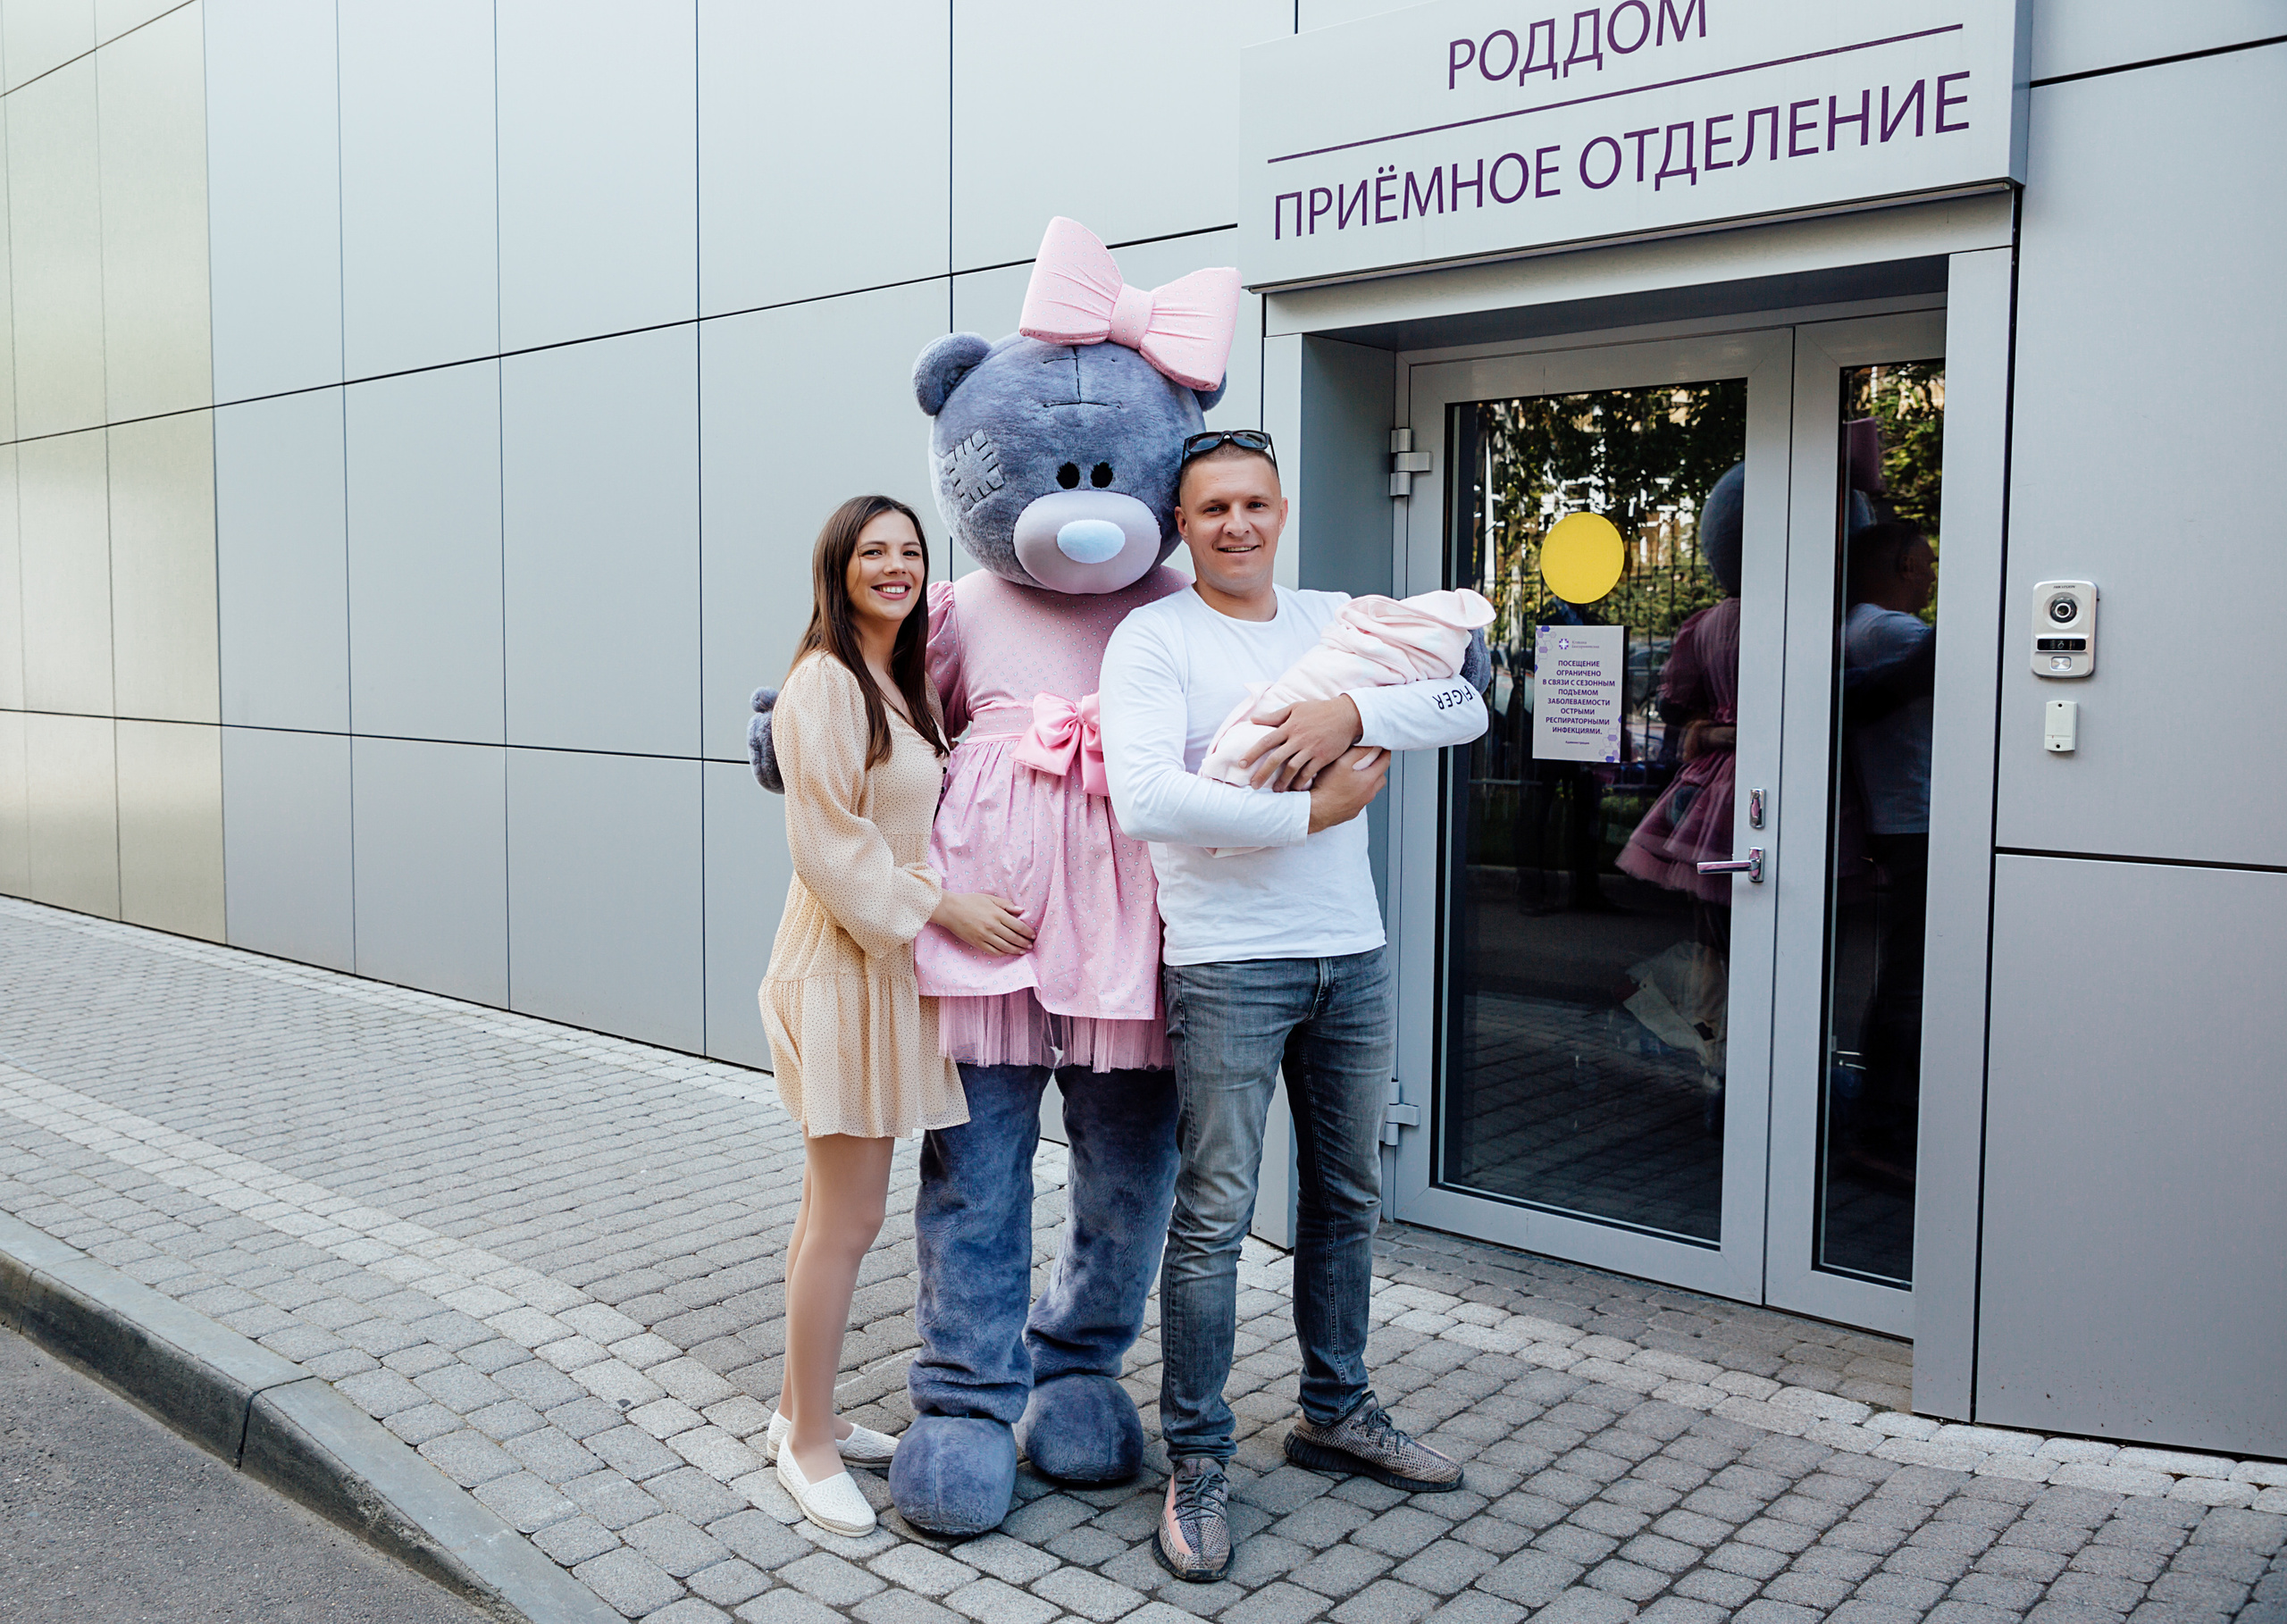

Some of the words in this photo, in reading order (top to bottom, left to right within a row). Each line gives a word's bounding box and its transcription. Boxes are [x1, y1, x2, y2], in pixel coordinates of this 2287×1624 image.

[1449, 0, 1706, 90] РОДДОМ
[1275, 145, 1561, 240] ПРИЁМНОЕ
[1579, 71, 1970, 191] ОТДЕЛЕНИЕ
[1547, 698, 1611, 706] ЗАБОЛЕВАЕМОСТИ
[1546, 716, 1610, 725] РЕСПИРАТОРНЫМИ
[1553, 726, 1603, 735] ИНФЕКЦИЯМИ.
